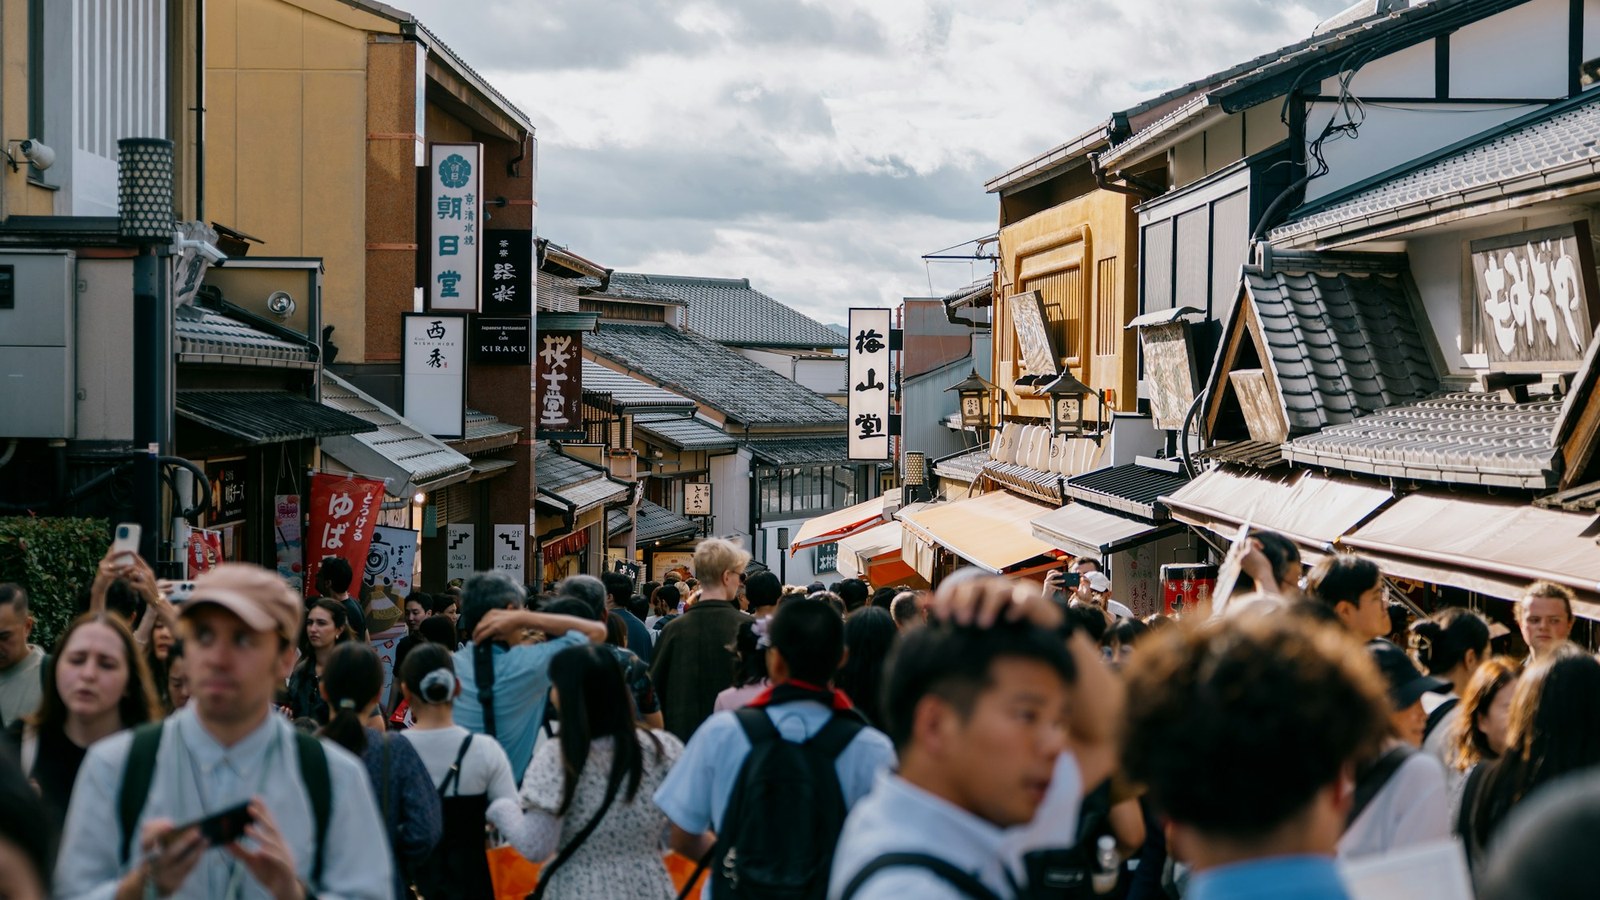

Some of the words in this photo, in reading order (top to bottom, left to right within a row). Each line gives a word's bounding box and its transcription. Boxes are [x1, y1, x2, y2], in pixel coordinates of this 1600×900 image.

[437, 194, 462, 298] 朝日堂
[855, 328, 886, 440] 梅山堂
[318, 492, 353, 568] ゆば
[353, 492, 374, 541] とろける
[511, 529, 523, 538] 2F
